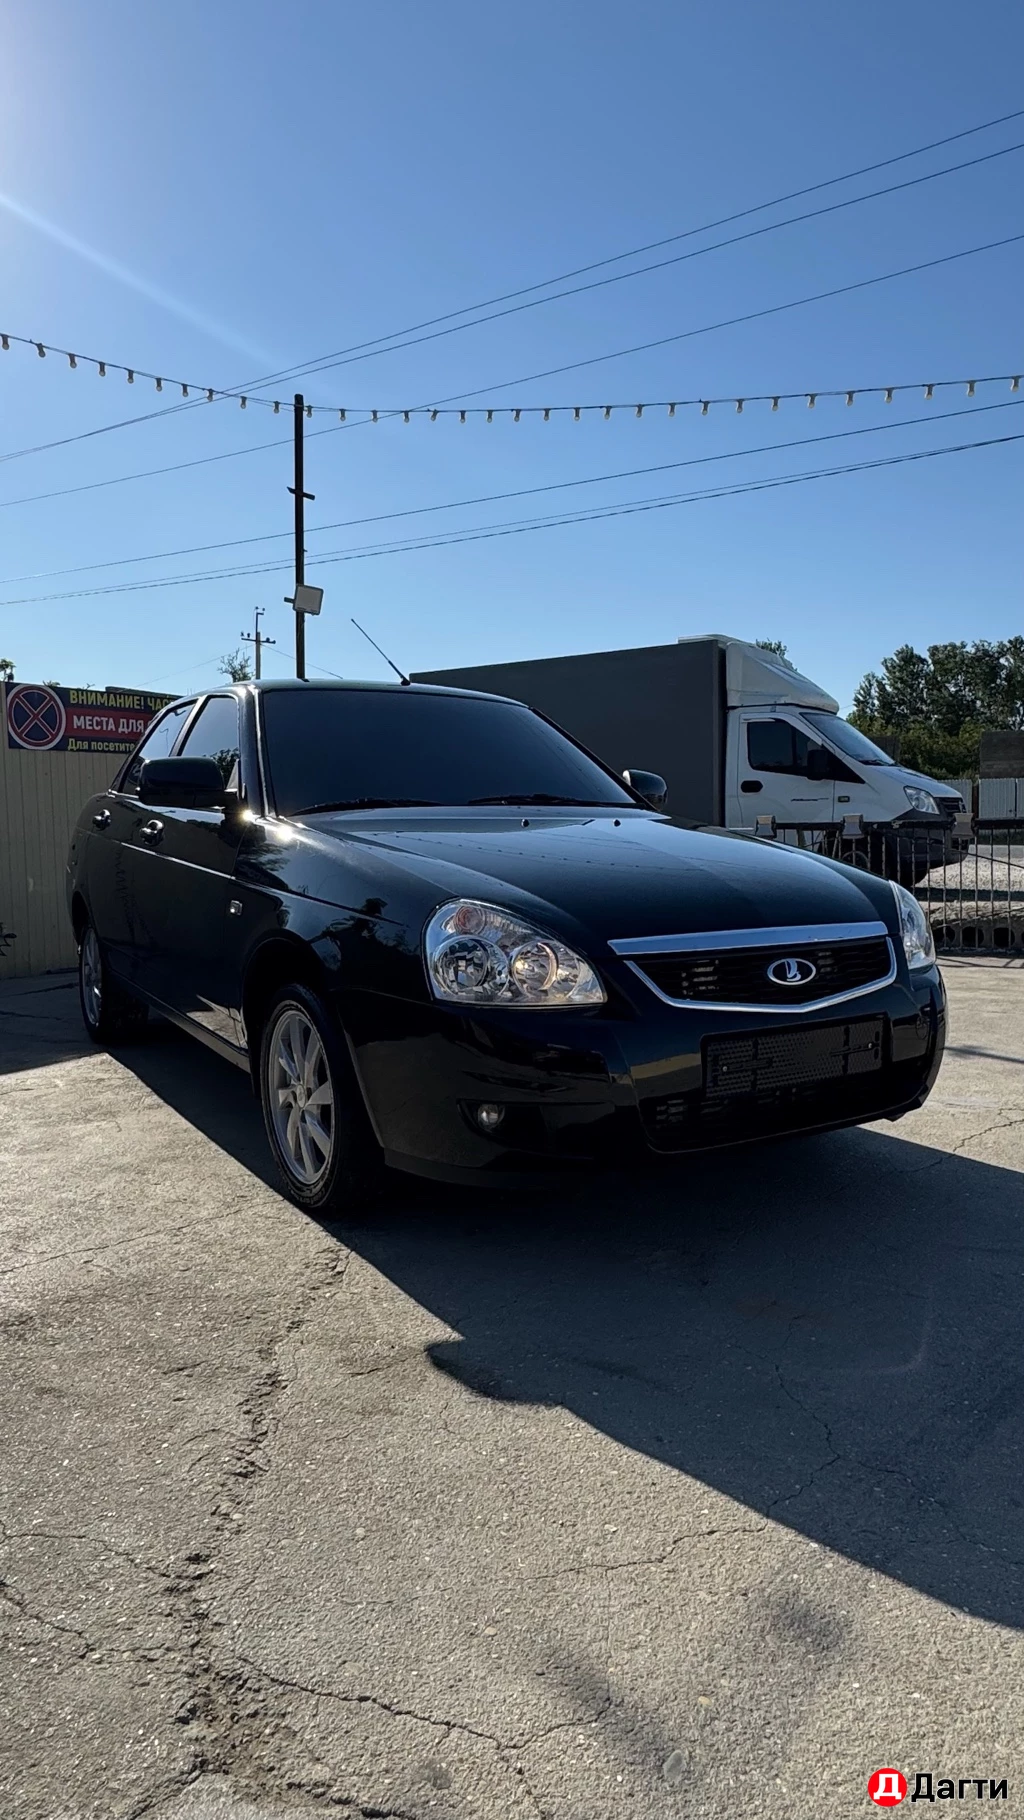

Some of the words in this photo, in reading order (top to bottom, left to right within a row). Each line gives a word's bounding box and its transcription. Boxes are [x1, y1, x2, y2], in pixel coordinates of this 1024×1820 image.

[70, 690, 144, 709] ВНИМАНИЕ!
[147, 697, 171, 711] ЧАС
[73, 715, 115, 731] МЕСТА
[118, 718, 144, 733] ДЛЯ
[67, 738, 88, 751] Для
